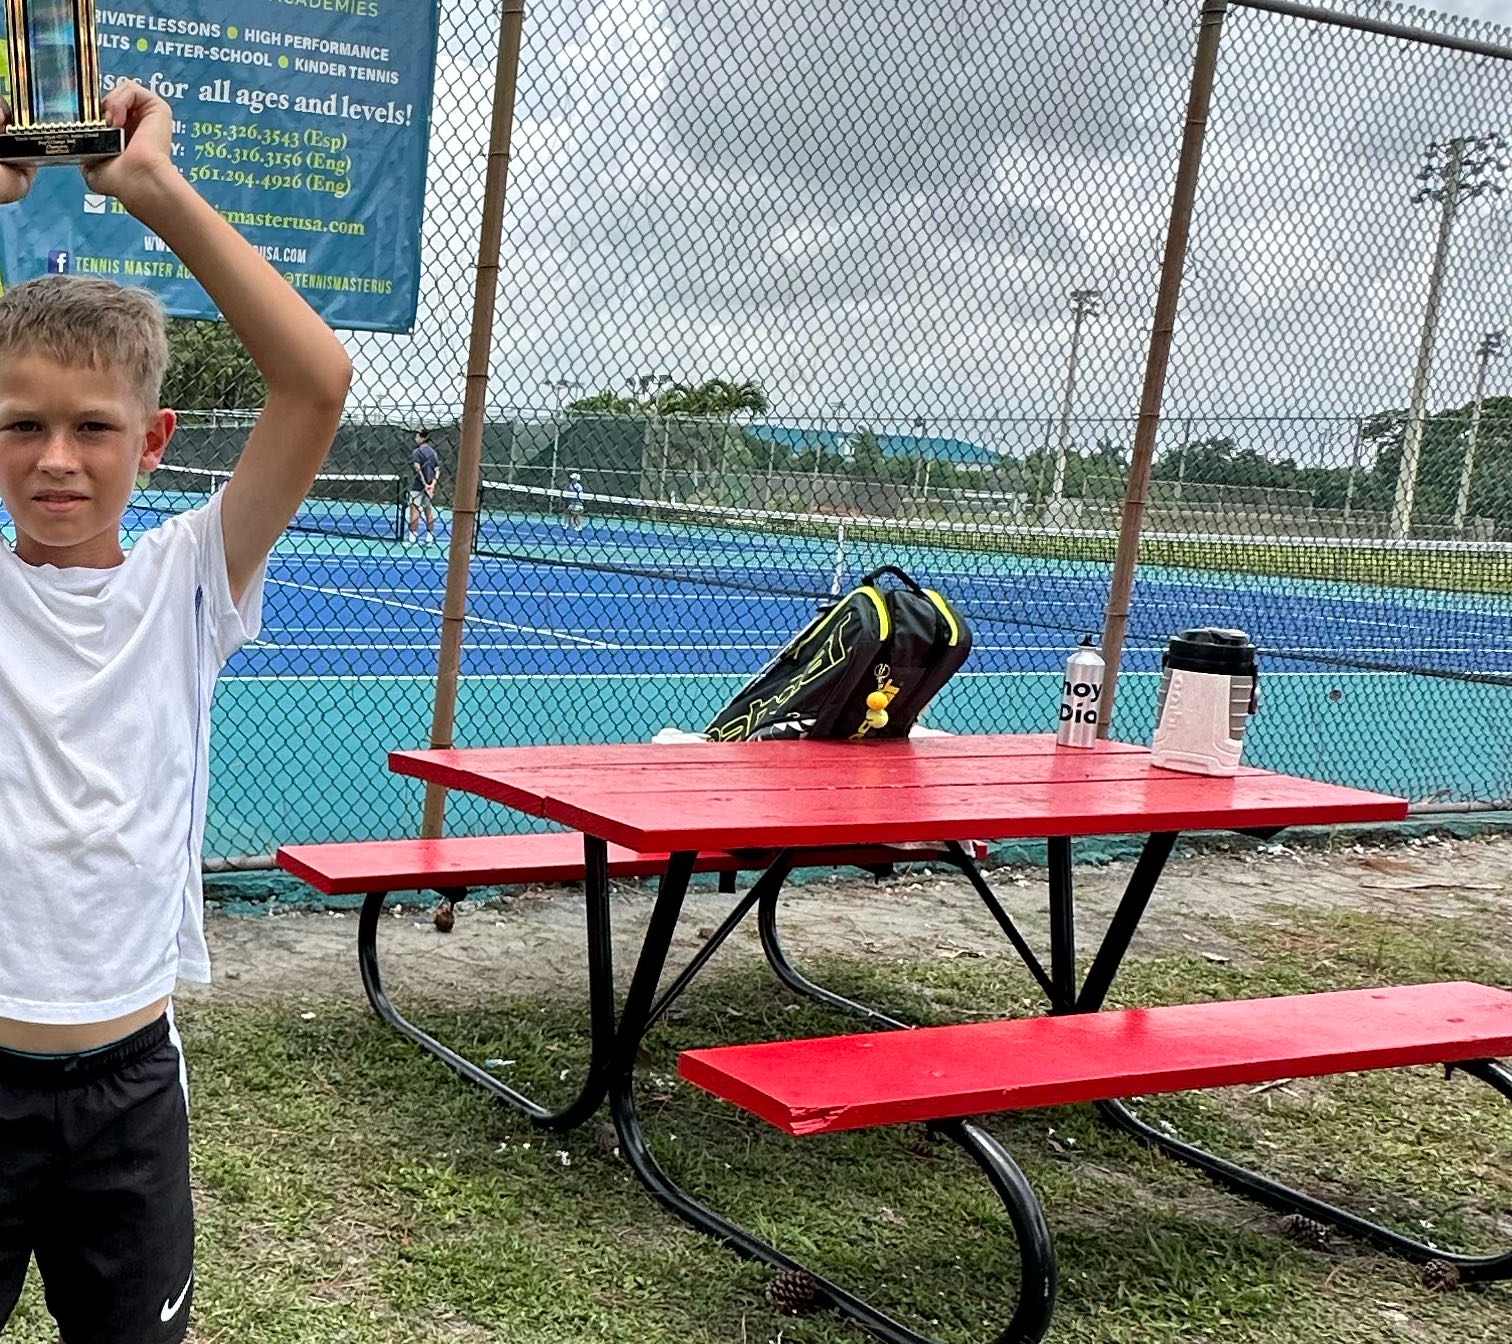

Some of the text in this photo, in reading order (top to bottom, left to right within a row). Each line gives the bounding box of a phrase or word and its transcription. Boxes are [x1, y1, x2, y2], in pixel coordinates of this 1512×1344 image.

[95, 9, 221, 38] RIVATE LESSONS
[153, 40, 273, 67] AFTER-SCHOOL
[244, 28, 390, 62] HIGH PERFORMANCE
[294, 57, 400, 85] KINDER TENNIS
[149, 72, 188, 99] for
[199, 79, 231, 104] all
[235, 85, 289, 114] ages
[293, 94, 337, 117] and
[340, 96, 413, 126] levels!
[191, 121, 299, 148] 305.326.3543
[303, 128, 348, 152] (Esp)
[195, 142, 302, 167] 786.316.3156
[306, 150, 352, 175] (Eng)
[189, 165, 303, 192] 561.294.4926
[306, 173, 352, 198] (Eng)
[74, 256, 120, 274] TENNIS
[124, 260, 174, 278] MASTER
